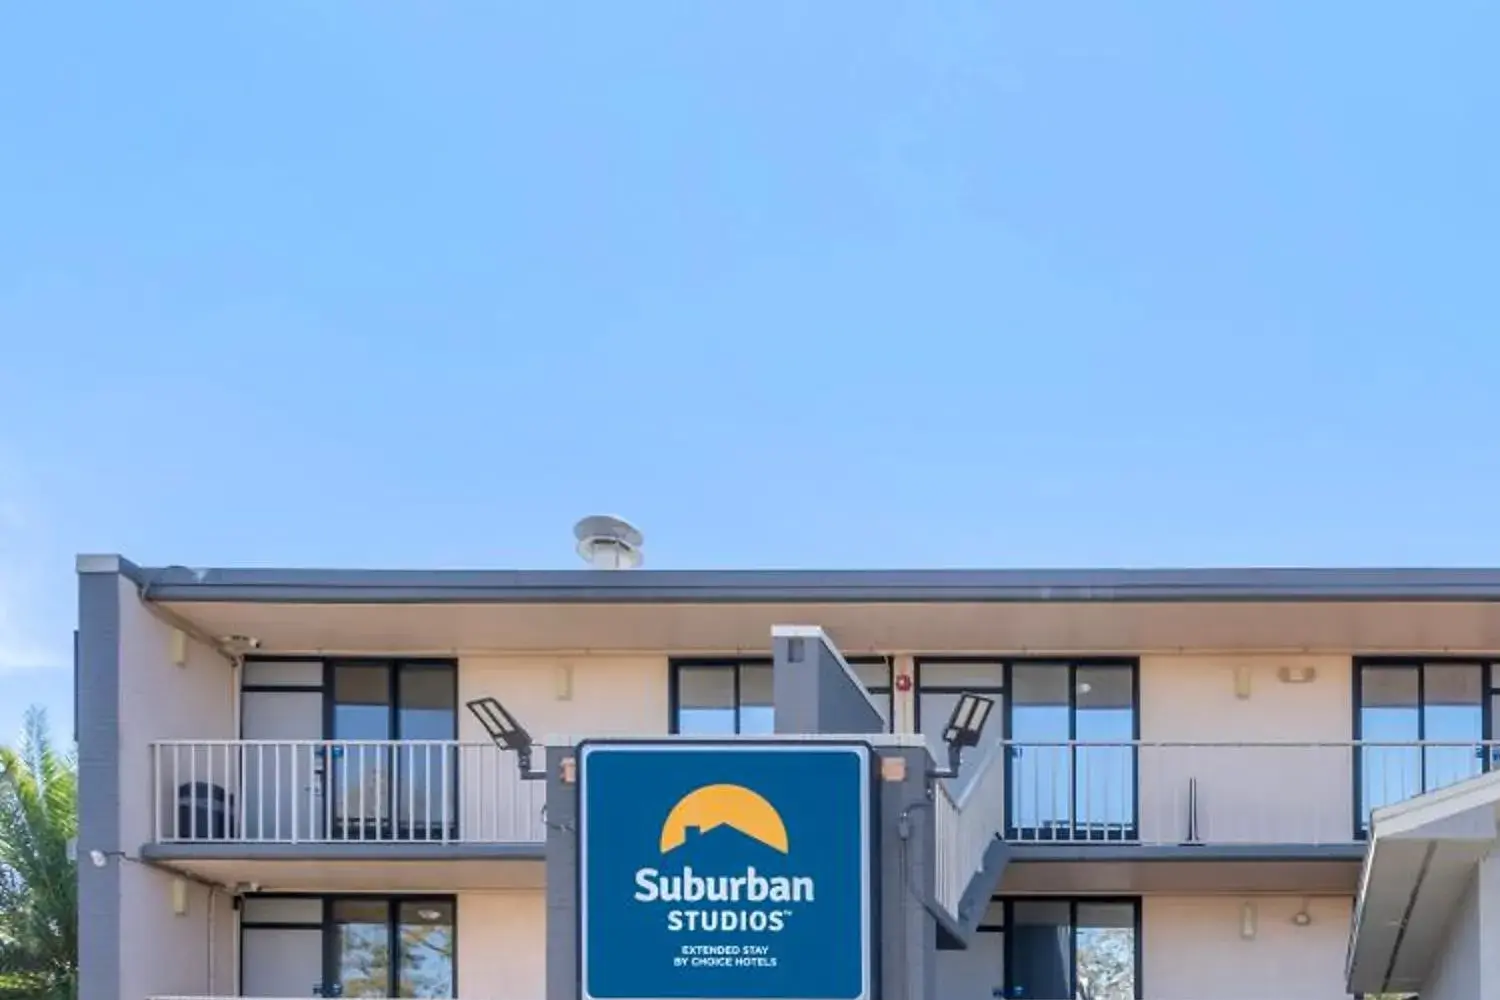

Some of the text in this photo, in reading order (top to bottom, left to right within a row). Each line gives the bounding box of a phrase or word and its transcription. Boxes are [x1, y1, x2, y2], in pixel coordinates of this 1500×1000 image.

[634, 866, 815, 902] Suburban
[681, 946, 769, 955] EXTENDED STAY
[674, 957, 777, 967] BY CHOICE HOTELS
